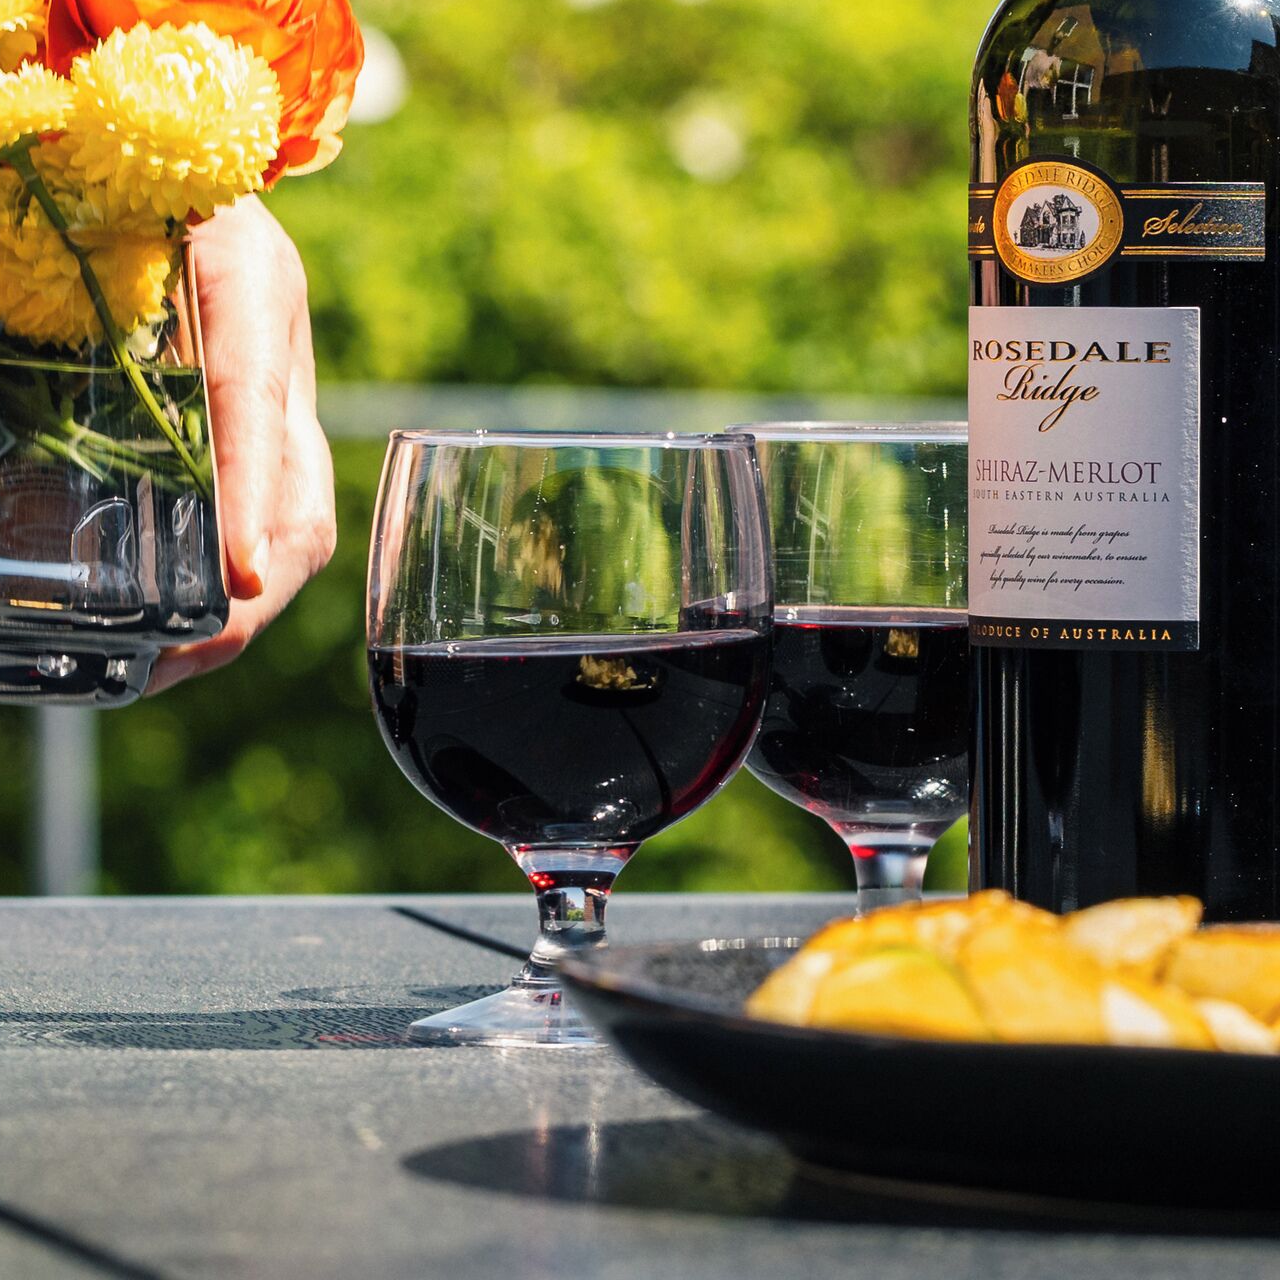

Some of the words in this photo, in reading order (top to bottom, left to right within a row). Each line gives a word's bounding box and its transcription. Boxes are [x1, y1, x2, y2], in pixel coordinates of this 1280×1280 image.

[1065, 170, 1114, 211] RIDGE
[1142, 202, 1244, 238] Selection
[973, 340, 1171, 363] ROSEDALE
[996, 363, 1100, 433] Ridge
[975, 458, 1162, 484] SHIRAZ-MERLOT
[1005, 490, 1064, 502] EASTERN
[1073, 492, 1170, 502] AUSTRALIA
[1016, 524, 1040, 543] Ridge
[1041, 528, 1049, 536] is
[1050, 526, 1074, 537] made
[1070, 523, 1097, 543] from
[1093, 530, 1130, 544] grapes
[1026, 546, 1036, 566] by
[1052, 548, 1103, 561] winemaker,
[1105, 553, 1115, 561] to
[989, 569, 1005, 589] high
[1001, 569, 1027, 590] quality
[1027, 575, 1047, 584] wine
[1043, 571, 1058, 591] for
[1060, 578, 1084, 591] every
[1084, 576, 1125, 585] occasion.
[1030, 627, 1050, 639] OF
[1060, 628, 1172, 641] AUSTRALIA
